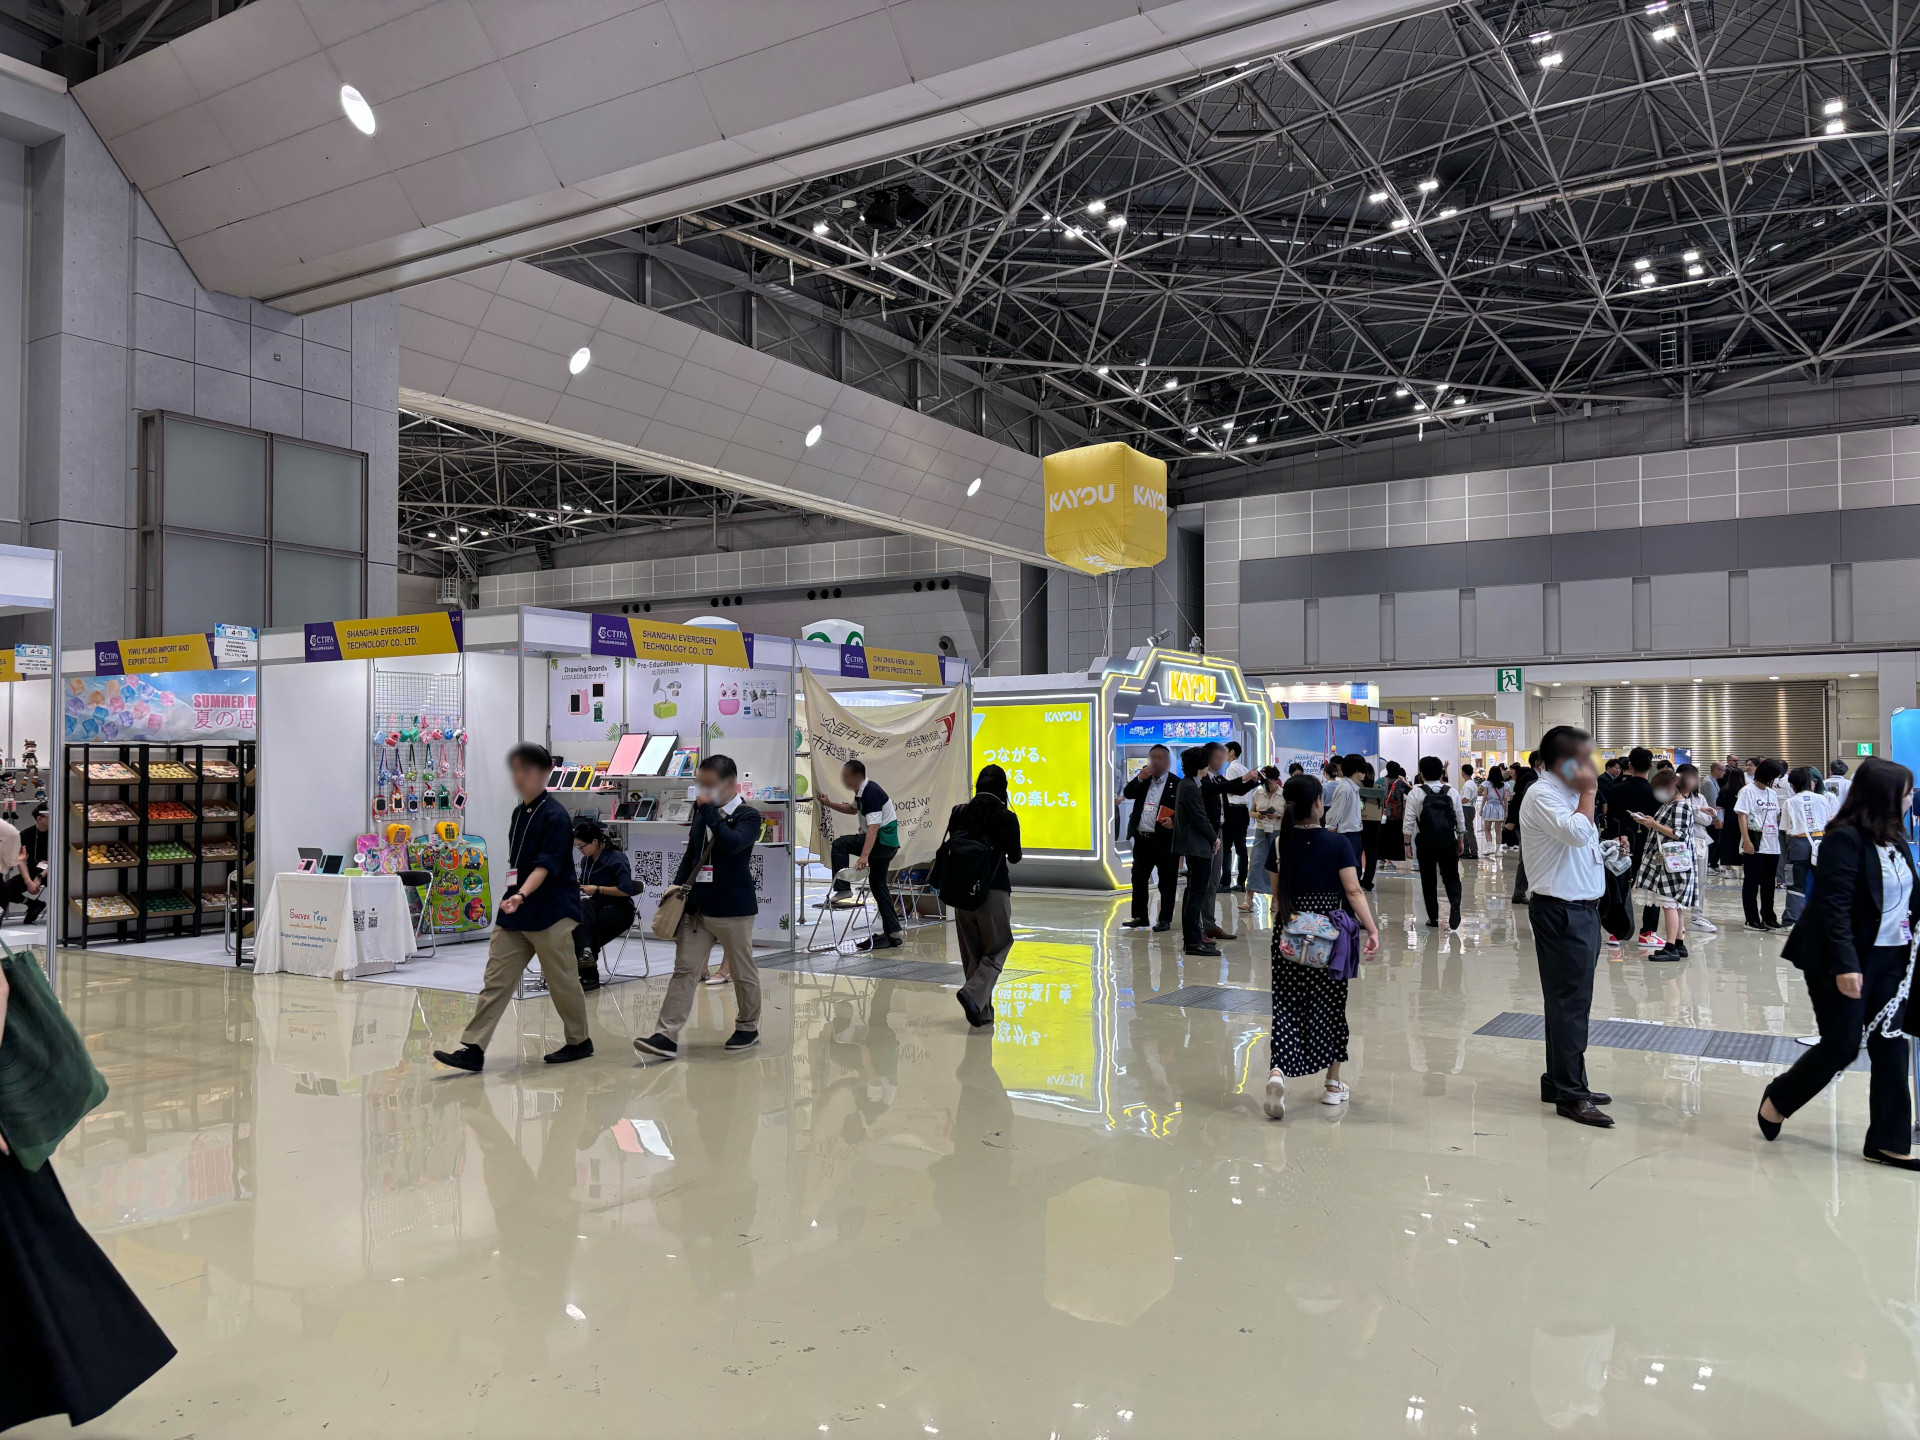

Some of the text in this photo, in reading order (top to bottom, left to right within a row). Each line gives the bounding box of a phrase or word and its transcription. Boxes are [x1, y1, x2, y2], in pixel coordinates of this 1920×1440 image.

[1050, 484, 1114, 512] KAYOU
[1134, 484, 1166, 515] KAYO
[346, 626, 420, 638] SHANGHAI EVERGREEN
[642, 630, 716, 646] SHANGHAI EVERGREEN
[347, 640, 388, 650] TECHNOLOGY
[643, 642, 714, 656] TECHNOLOGY CO., LTD.
[1168, 670, 1217, 704] KAYOU
[194, 694, 256, 708] SUMMER M
[193, 709, 256, 729] 夏の思
[1044, 711, 1082, 722] KAYOU
[983, 746, 1046, 762] つながる、
[1007, 790, 1076, 807] の楽しさ。
